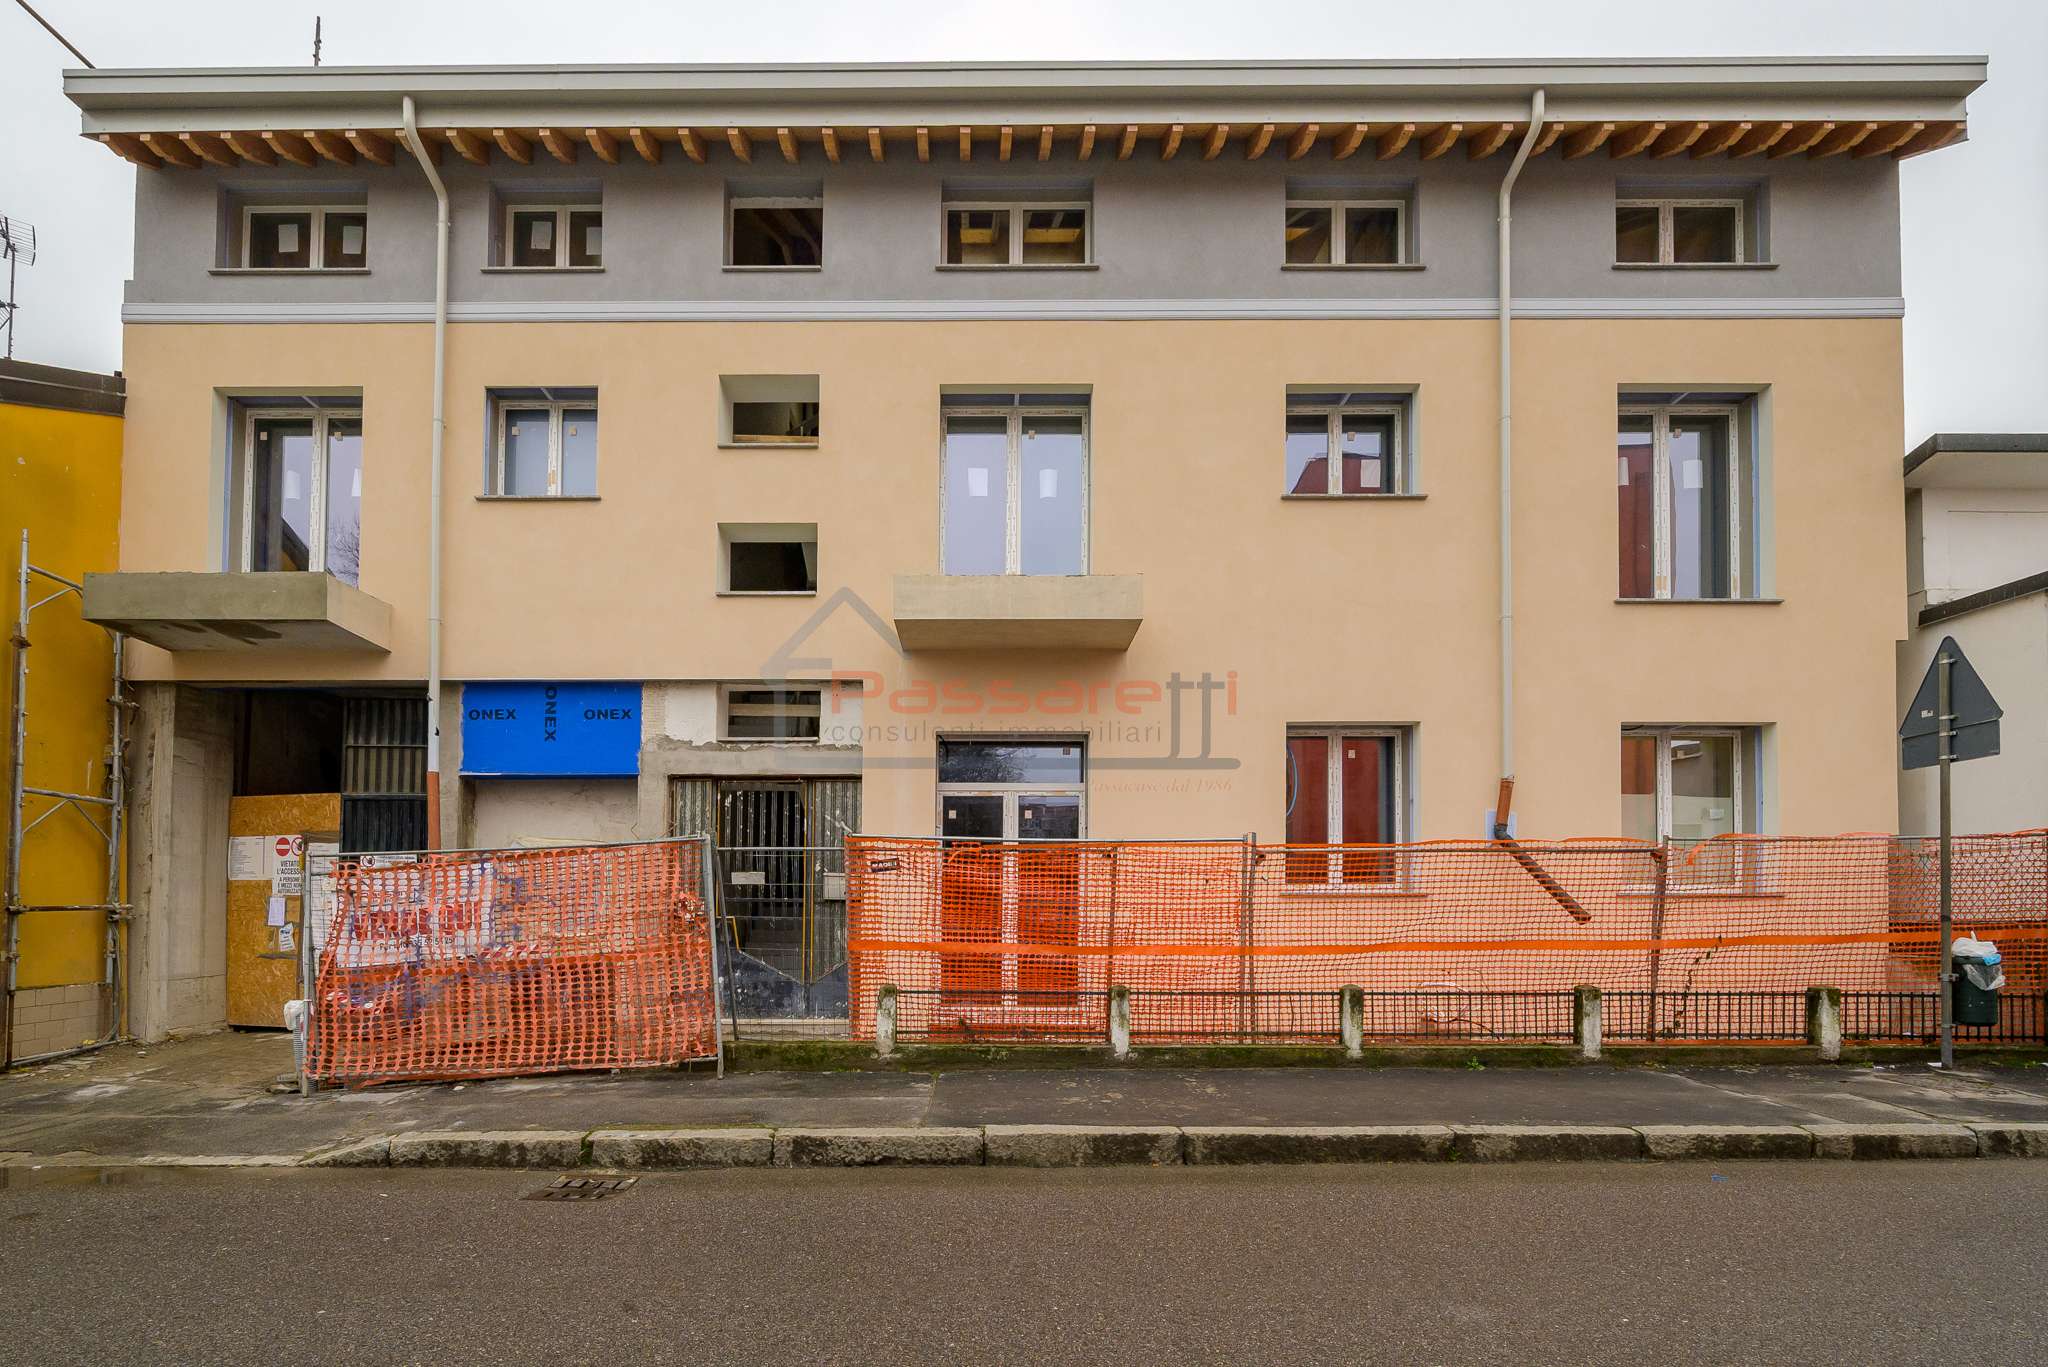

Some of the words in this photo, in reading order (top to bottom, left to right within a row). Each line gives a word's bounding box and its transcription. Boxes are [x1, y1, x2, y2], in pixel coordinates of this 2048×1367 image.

[468, 708, 517, 721] ONEX
[545, 686, 558, 742] ONEX
[584, 708, 632, 720] ONEX
